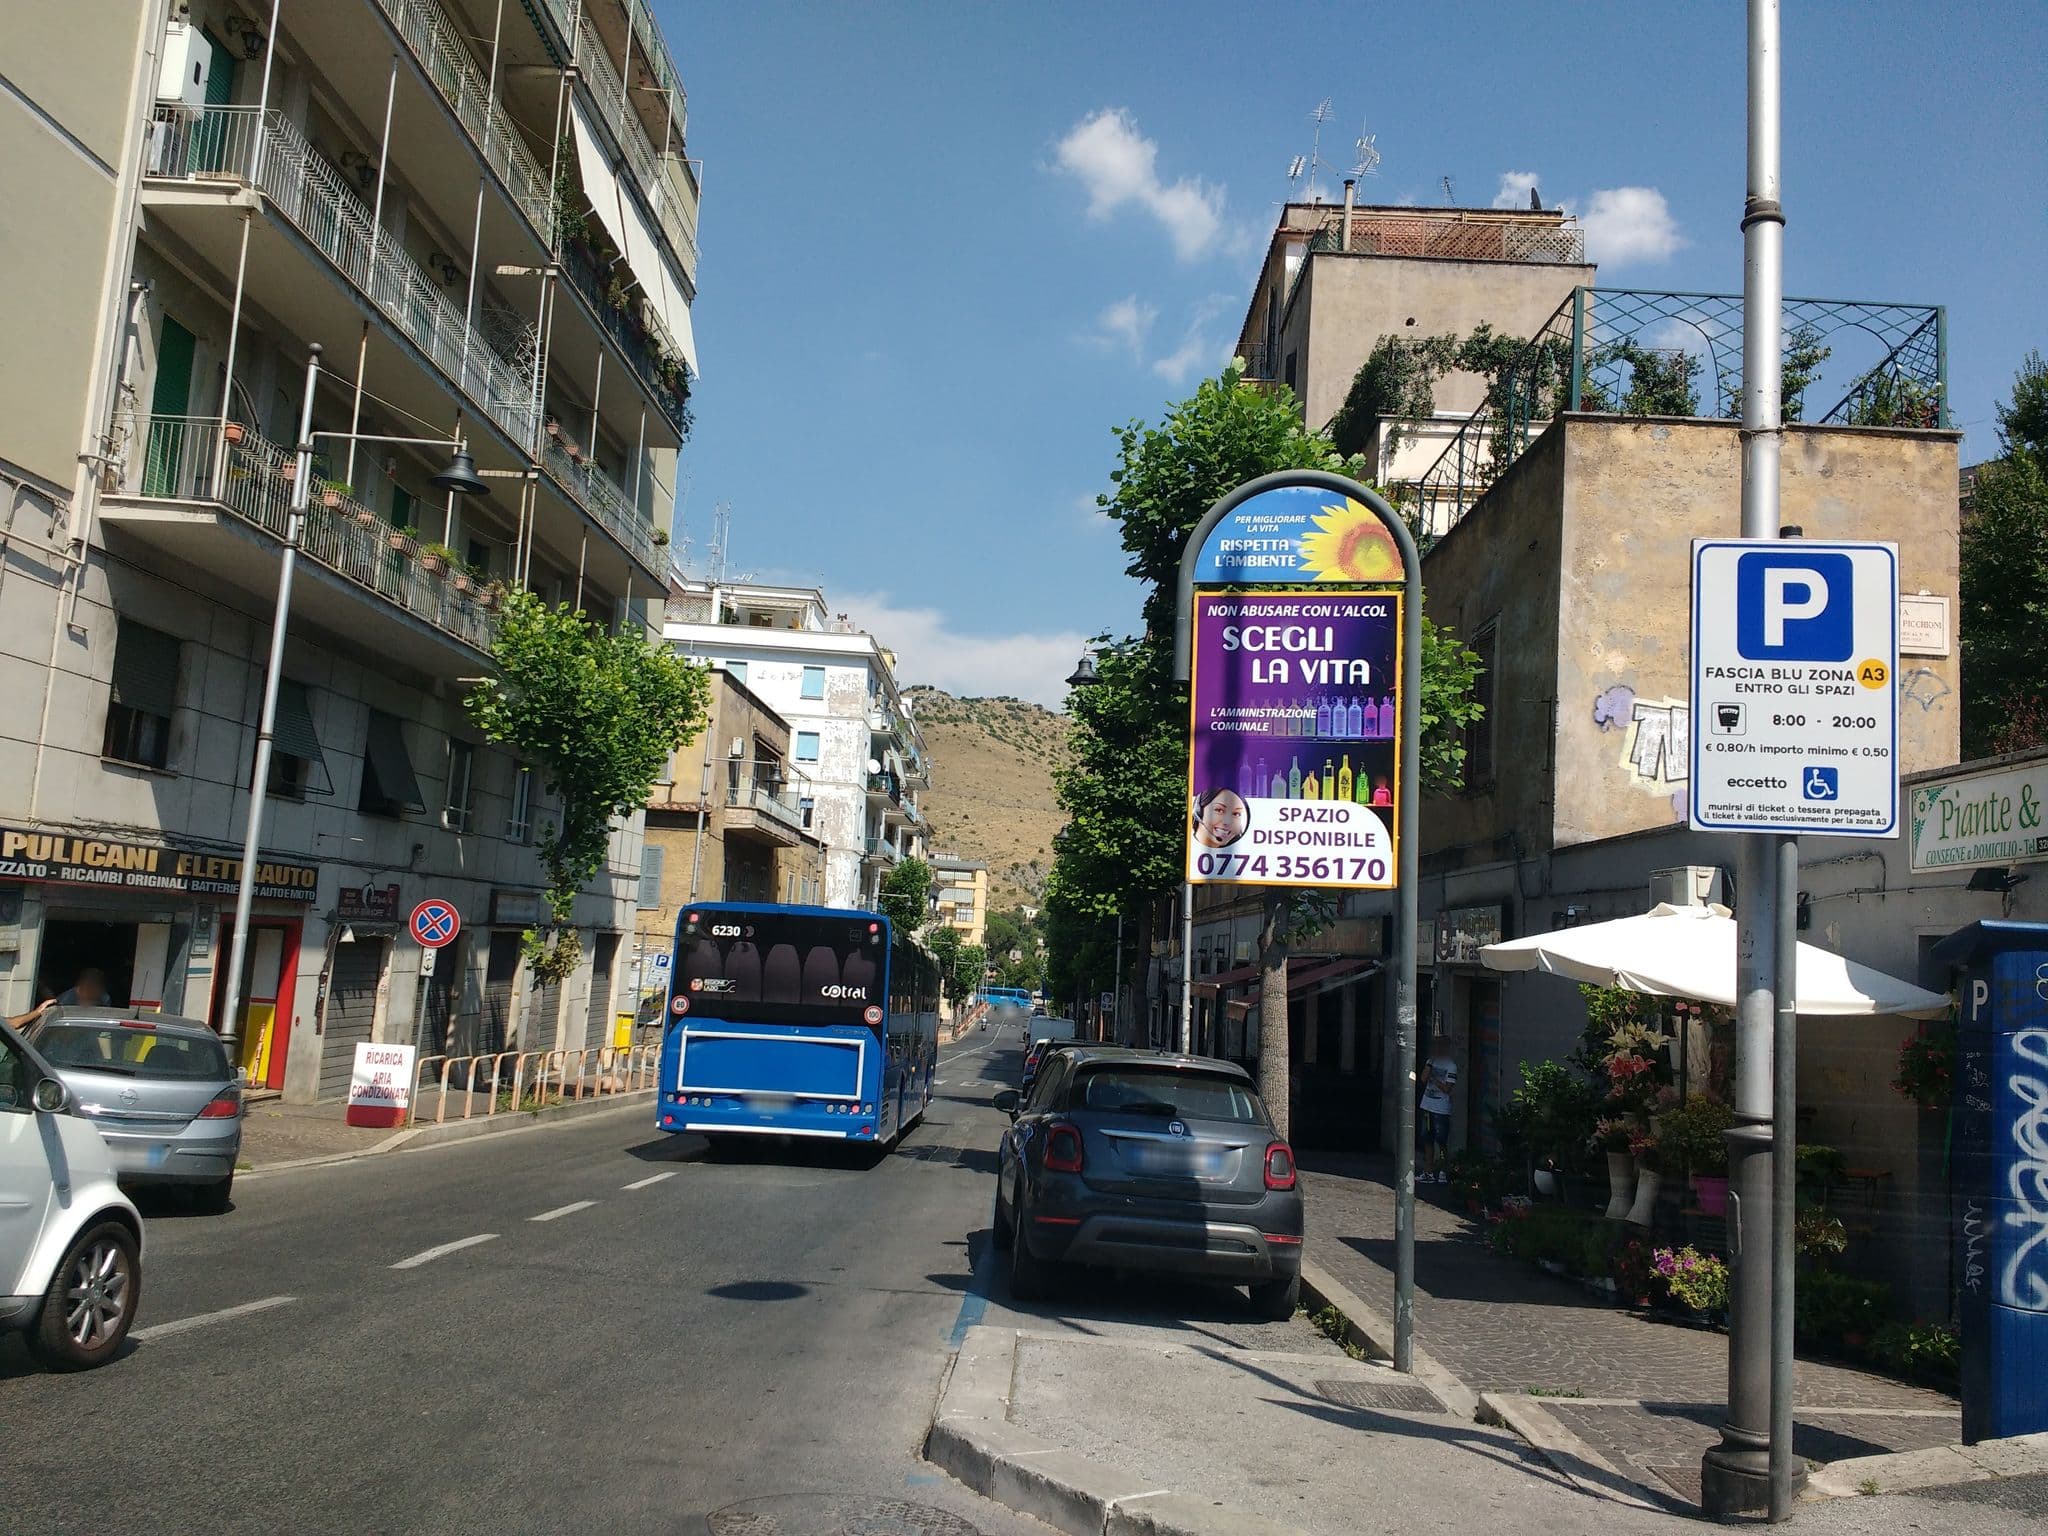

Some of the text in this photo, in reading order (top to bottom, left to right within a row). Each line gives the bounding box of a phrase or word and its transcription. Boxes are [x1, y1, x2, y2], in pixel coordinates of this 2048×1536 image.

[1235, 515, 1306, 524] PER MIGLIORARE
[1220, 539, 1289, 551] RISPETTA
[1214, 555, 1297, 567] L'AMBIENTE
[1207, 605, 1388, 617] NON ABUSARE CON L'ALCOL
[1764, 567, 1829, 647] P
[1222, 626, 1334, 651] SCEGLI
[1252, 658, 1370, 685] LA VITA
[1705, 667, 1885, 682] FASCIA BLU ZONA A3
[1735, 683, 1855, 696] ENTRO GLI SPAZI
[1210, 708, 1317, 719] L'AMMINISTRAZIONE
[1210, 721, 1269, 732] COMUNALE
[1772, 714, 1806, 727] 8:00
[1832, 716, 1876, 729] 20:00
[1705, 743, 1712, 752] €
[1760, 744, 1804, 757] importo
[1807, 746, 1849, 756] minimo
[1852, 748, 1858, 757] €
[1727, 776, 1787, 789] eccetto
[1279, 807, 1350, 823] SPAZIO
[1708, 802, 1743, 812] munirsi
[1746, 804, 1755, 812] di
[1758, 804, 1785, 813] ticket
[1797, 806, 1831, 815] tessera
[1834, 807, 1881, 818] prepagata
[1939, 784, 2041, 841] Piante &
[1712, 812, 1735, 820] ticket
[1744, 813, 1768, 821] valido
[1770, 814, 1829, 824] esclusivamente
[1831, 817, 1844, 826] per
[1846, 816, 1853, 825] la
[1876, 817, 1887, 826] A3
[1253, 830, 1375, 848] DISPONIBILE
[2, 831, 158, 872] PULICANI
[1926, 846, 1966, 865] CONSEGNE
[1973, 840, 2017, 859] DOMICILIO
[1197, 853, 1386, 881] 0774 356170
[61, 867, 122, 884] RICAMBI
[126, 873, 188, 890] ORIGINALI
[191, 880, 239, 894] BATTERIE
[712, 925, 741, 937] 6230
[659, 957, 667, 965] P
[821, 985, 867, 1000] cotral
[1972, 979, 1988, 1021] P
[366, 1051, 403, 1066] RICARICA
[372, 1072, 392, 1085] ARIA
[351, 1085, 409, 1100] CONDIZIONATA
